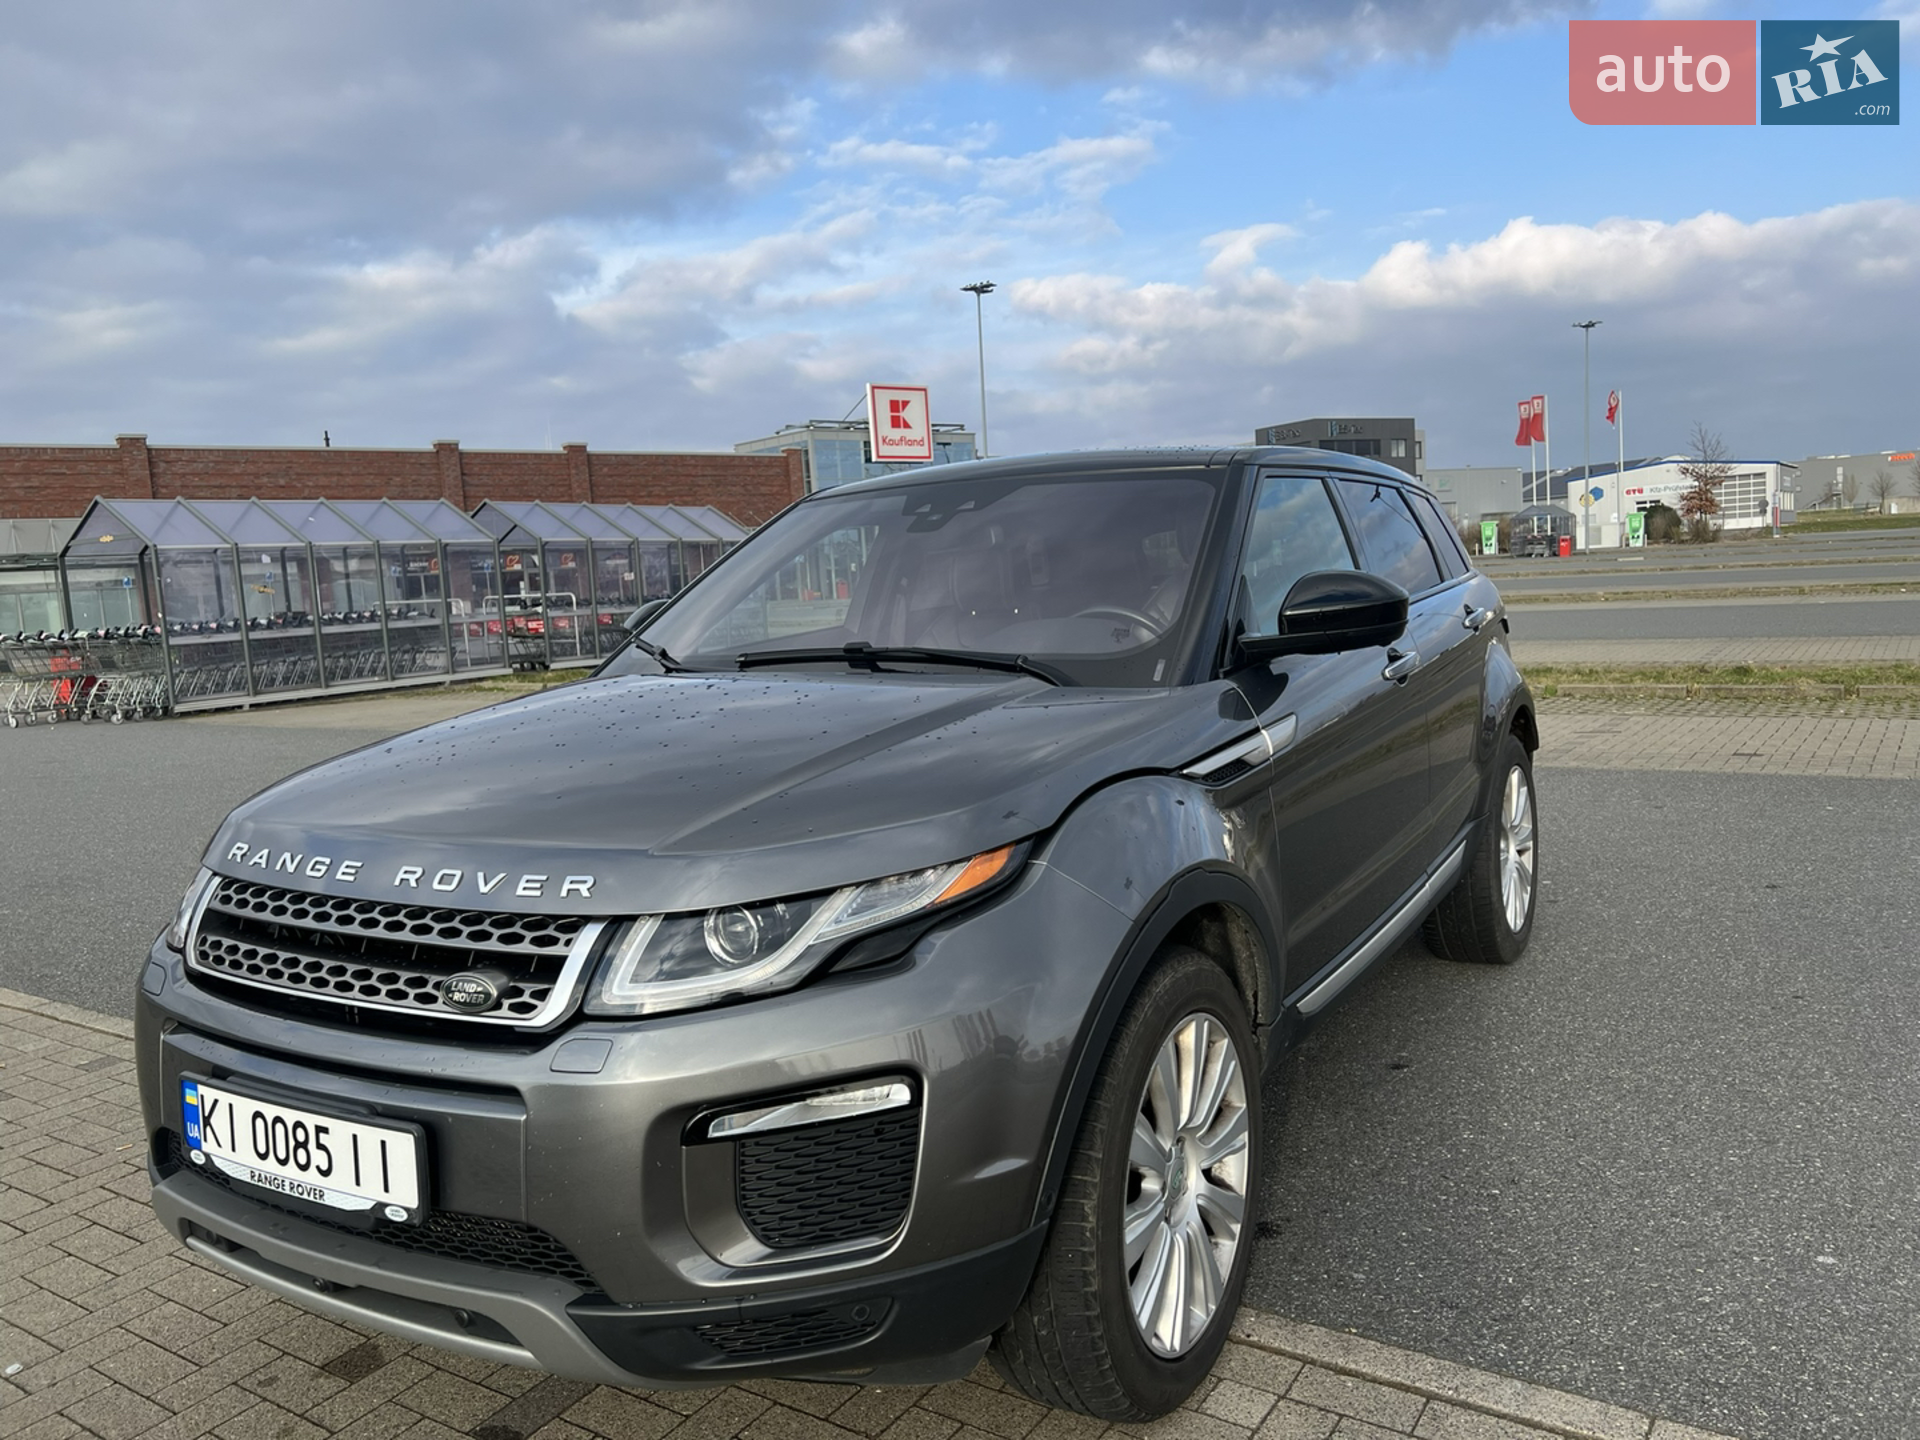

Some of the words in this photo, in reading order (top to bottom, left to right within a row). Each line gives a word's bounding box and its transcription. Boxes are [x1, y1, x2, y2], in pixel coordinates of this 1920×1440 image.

[882, 435, 925, 447] Kaufland
[227, 841, 364, 882] RANGE
[393, 865, 597, 899] ROVER
[451, 981, 477, 993] LAND
[452, 991, 485, 1004] ROVER
[187, 1121, 201, 1140] UA
[251, 1110, 333, 1178] 0085
[250, 1170, 287, 1192] RANGE
[289, 1181, 326, 1202] ROVER
